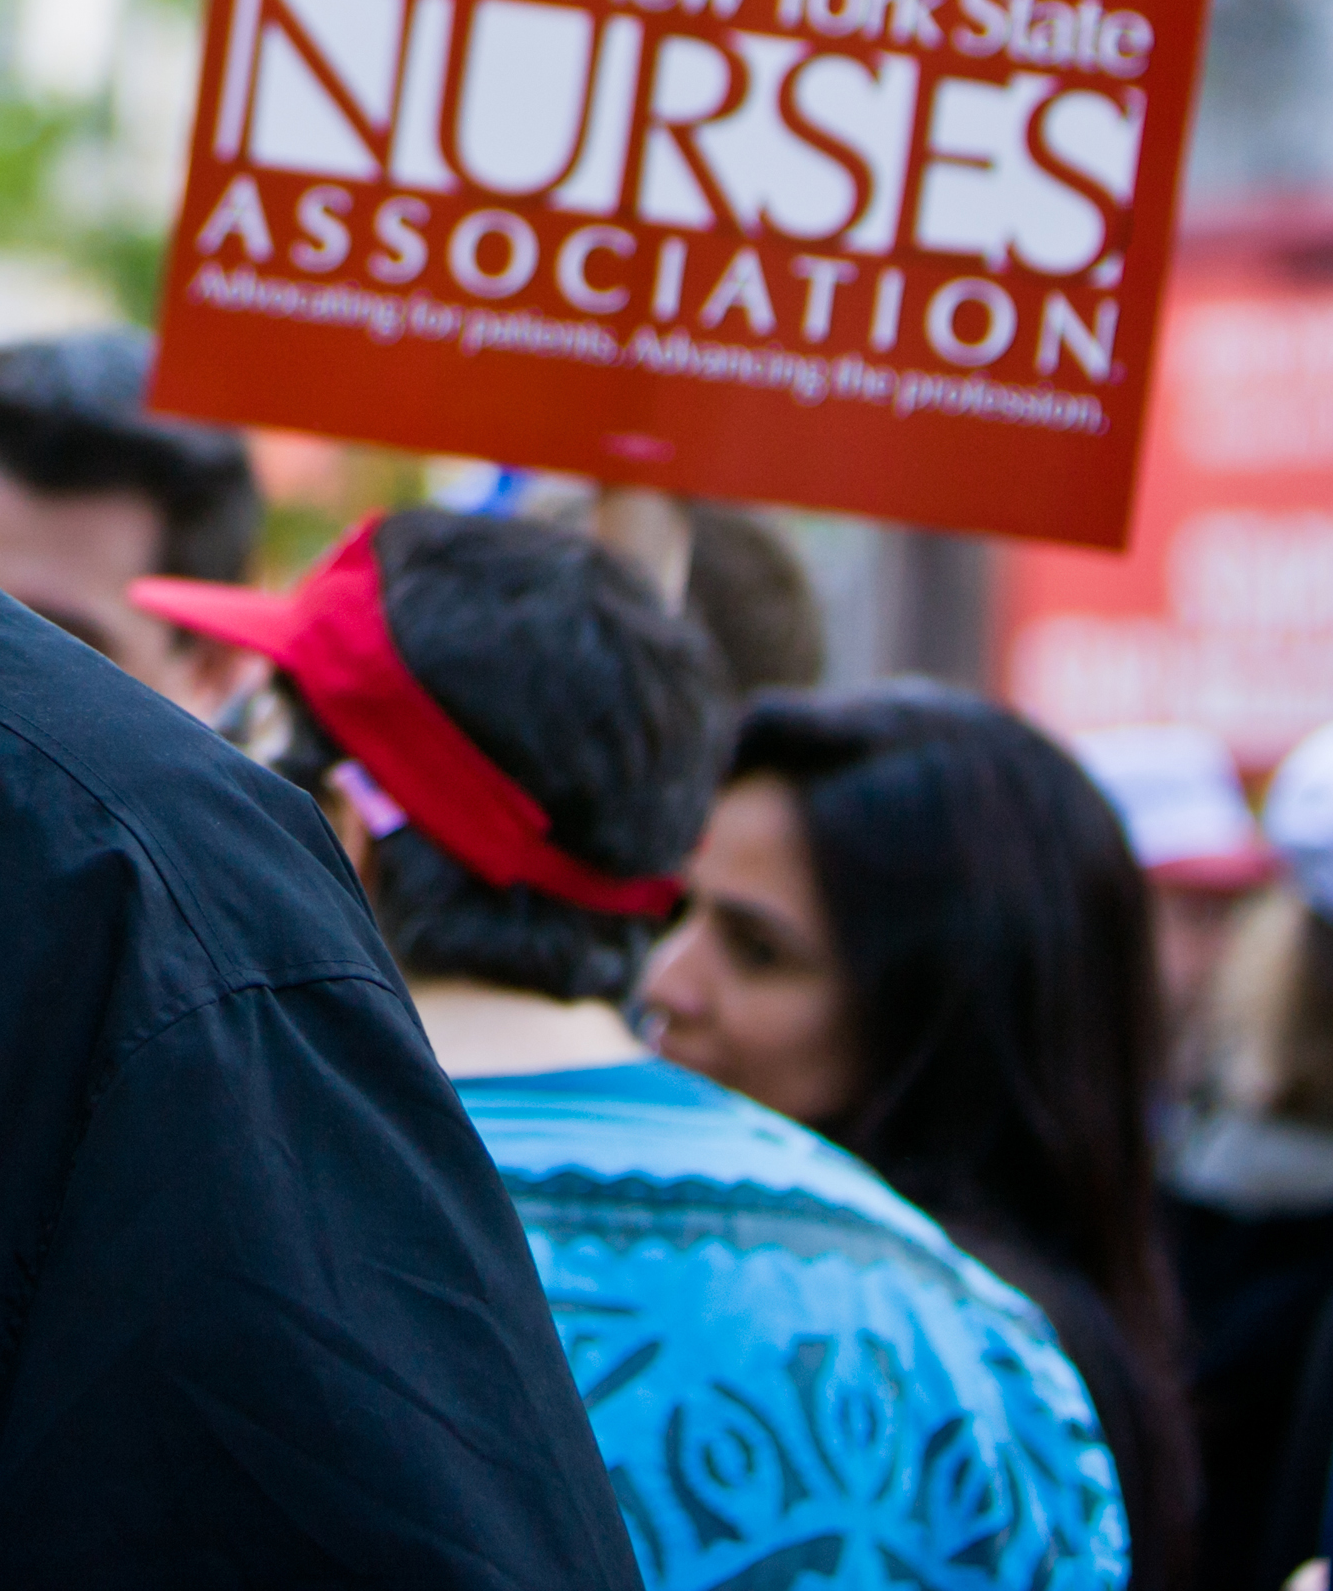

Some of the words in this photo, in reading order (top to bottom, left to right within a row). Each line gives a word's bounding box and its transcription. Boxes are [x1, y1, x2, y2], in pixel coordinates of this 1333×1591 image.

[188, 262, 405, 346] Advocating
[832, 352, 898, 407] the
[196, 173, 1121, 382] ASSOCIATION
